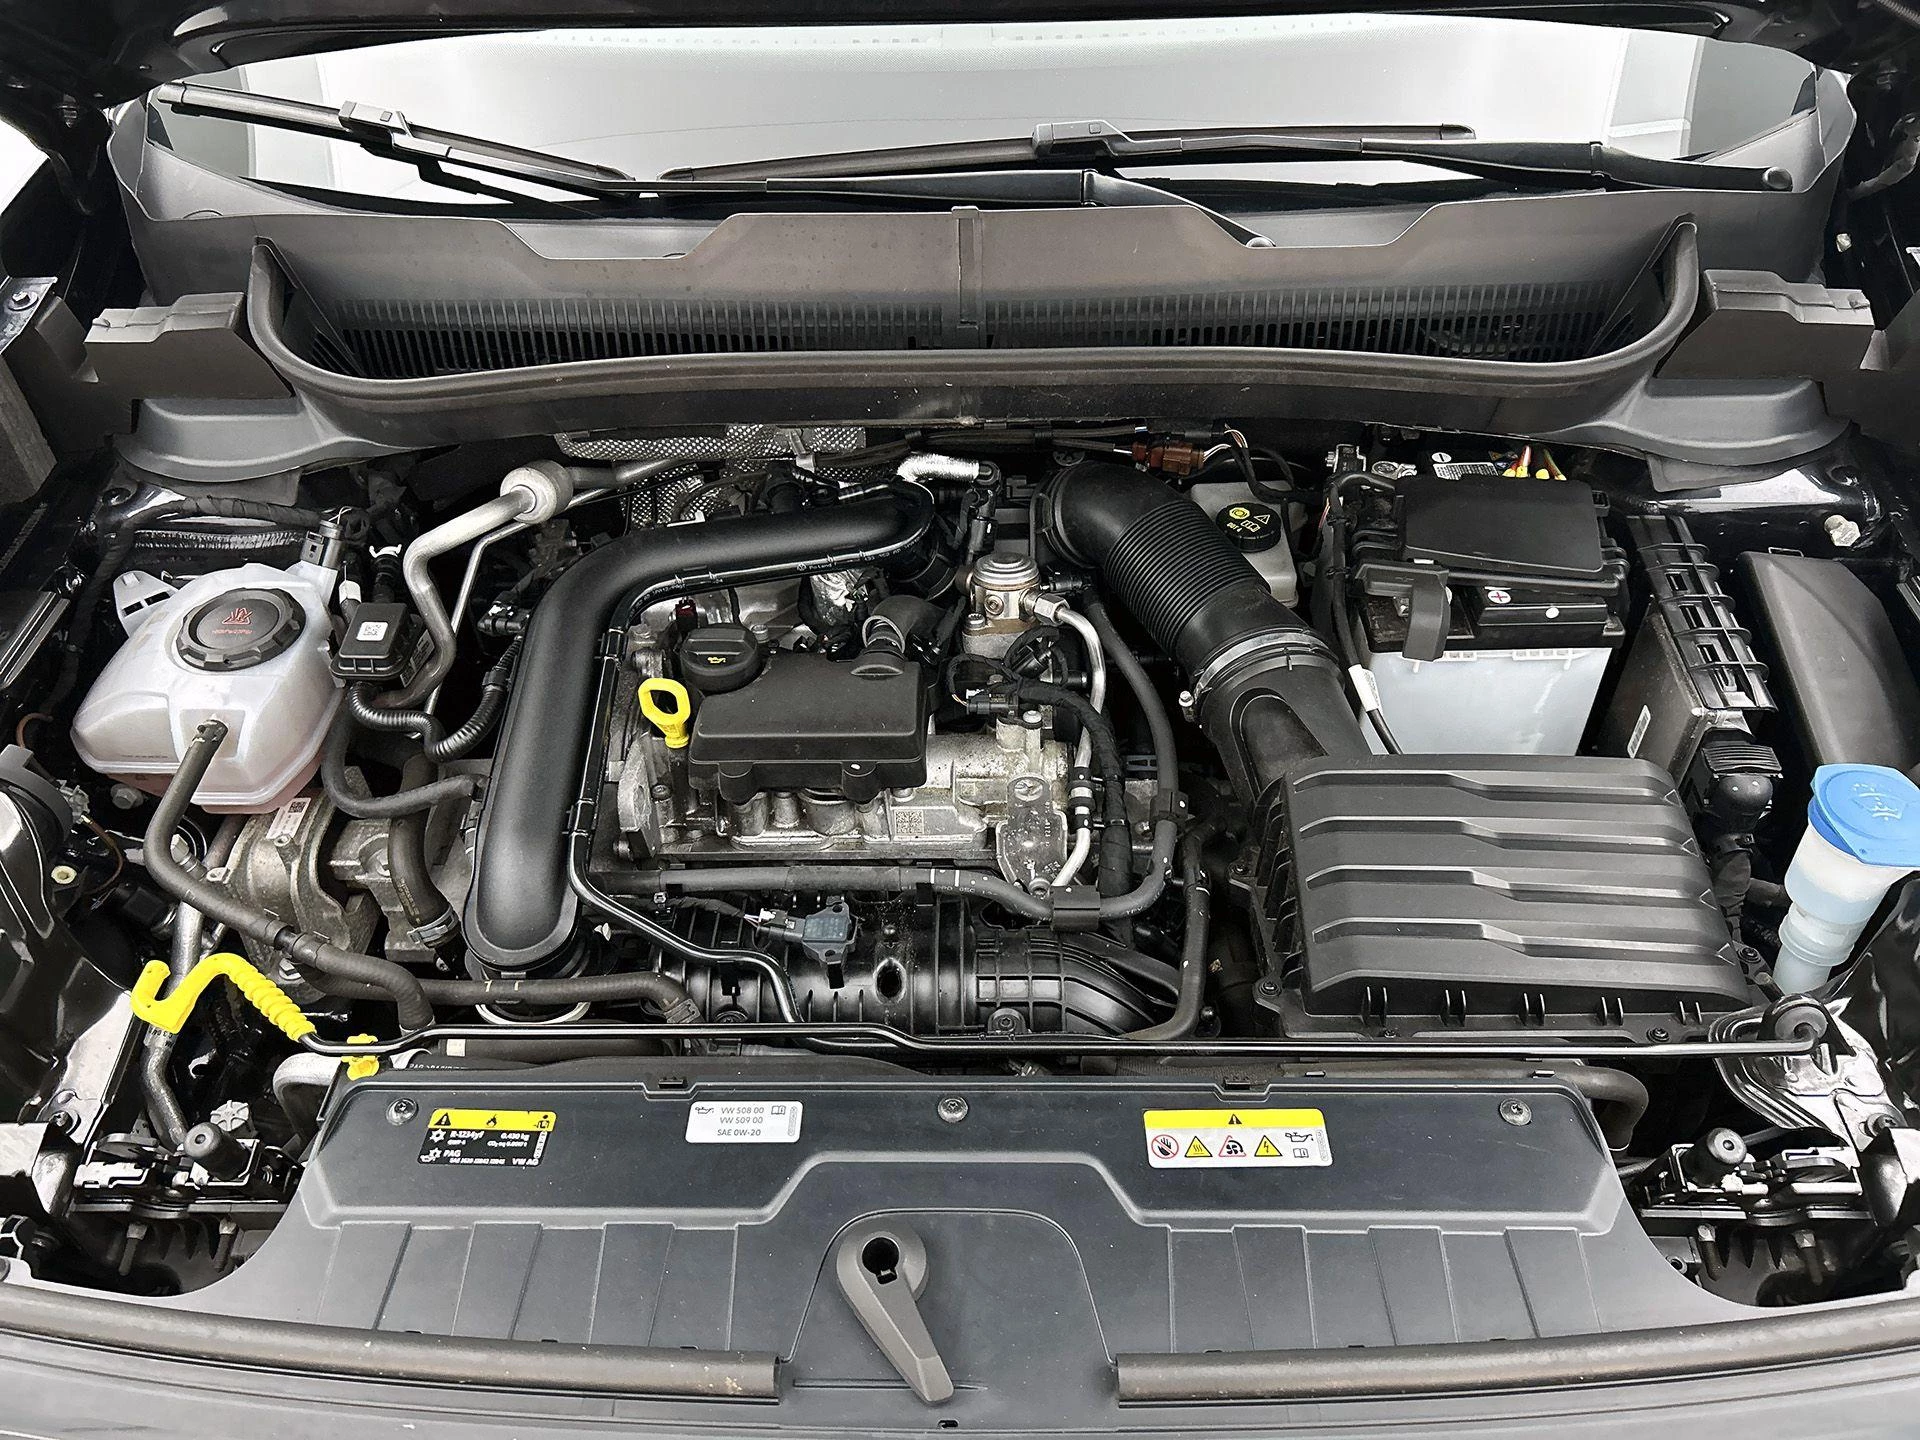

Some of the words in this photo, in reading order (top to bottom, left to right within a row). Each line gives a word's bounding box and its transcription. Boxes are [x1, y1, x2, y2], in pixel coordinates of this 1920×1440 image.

[721, 1106, 735, 1114] VW
[736, 1106, 752, 1114] 508
[753, 1106, 765, 1114] 00
[719, 1116, 734, 1124] VW
[735, 1116, 751, 1124] 509
[752, 1116, 764, 1124] 00
[443, 1149, 461, 1158] PAG
[526, 1158, 539, 1166] AG
